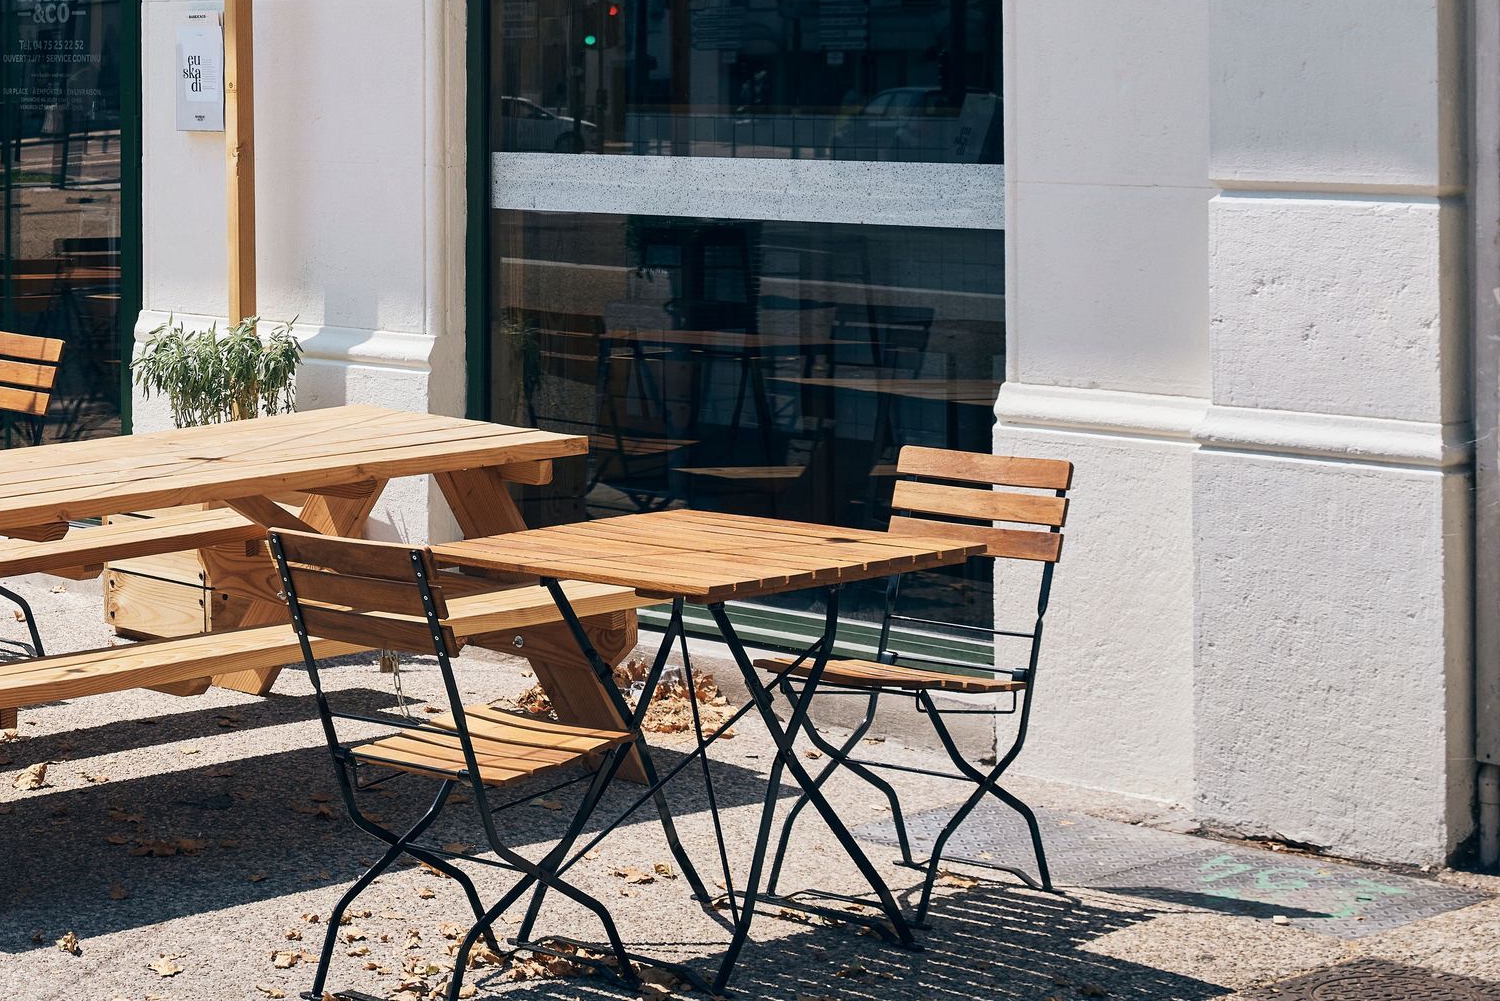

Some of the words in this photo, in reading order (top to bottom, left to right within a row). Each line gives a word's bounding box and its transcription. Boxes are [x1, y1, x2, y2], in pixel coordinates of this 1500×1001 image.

[33, 3, 70, 23] &CO
[33, 40, 42, 50] 04
[43, 40, 53, 50] 75
[53, 40, 63, 50] 25
[64, 40, 73, 49] 22
[74, 40, 84, 49] 52
[3, 54, 26, 63] OUVERT
[46, 54, 72, 63] SERVICE
[72, 54, 101, 63] CONTINU
[187, 55, 201, 66] eu
[183, 63, 201, 79] ska
[191, 77, 202, 92] di
